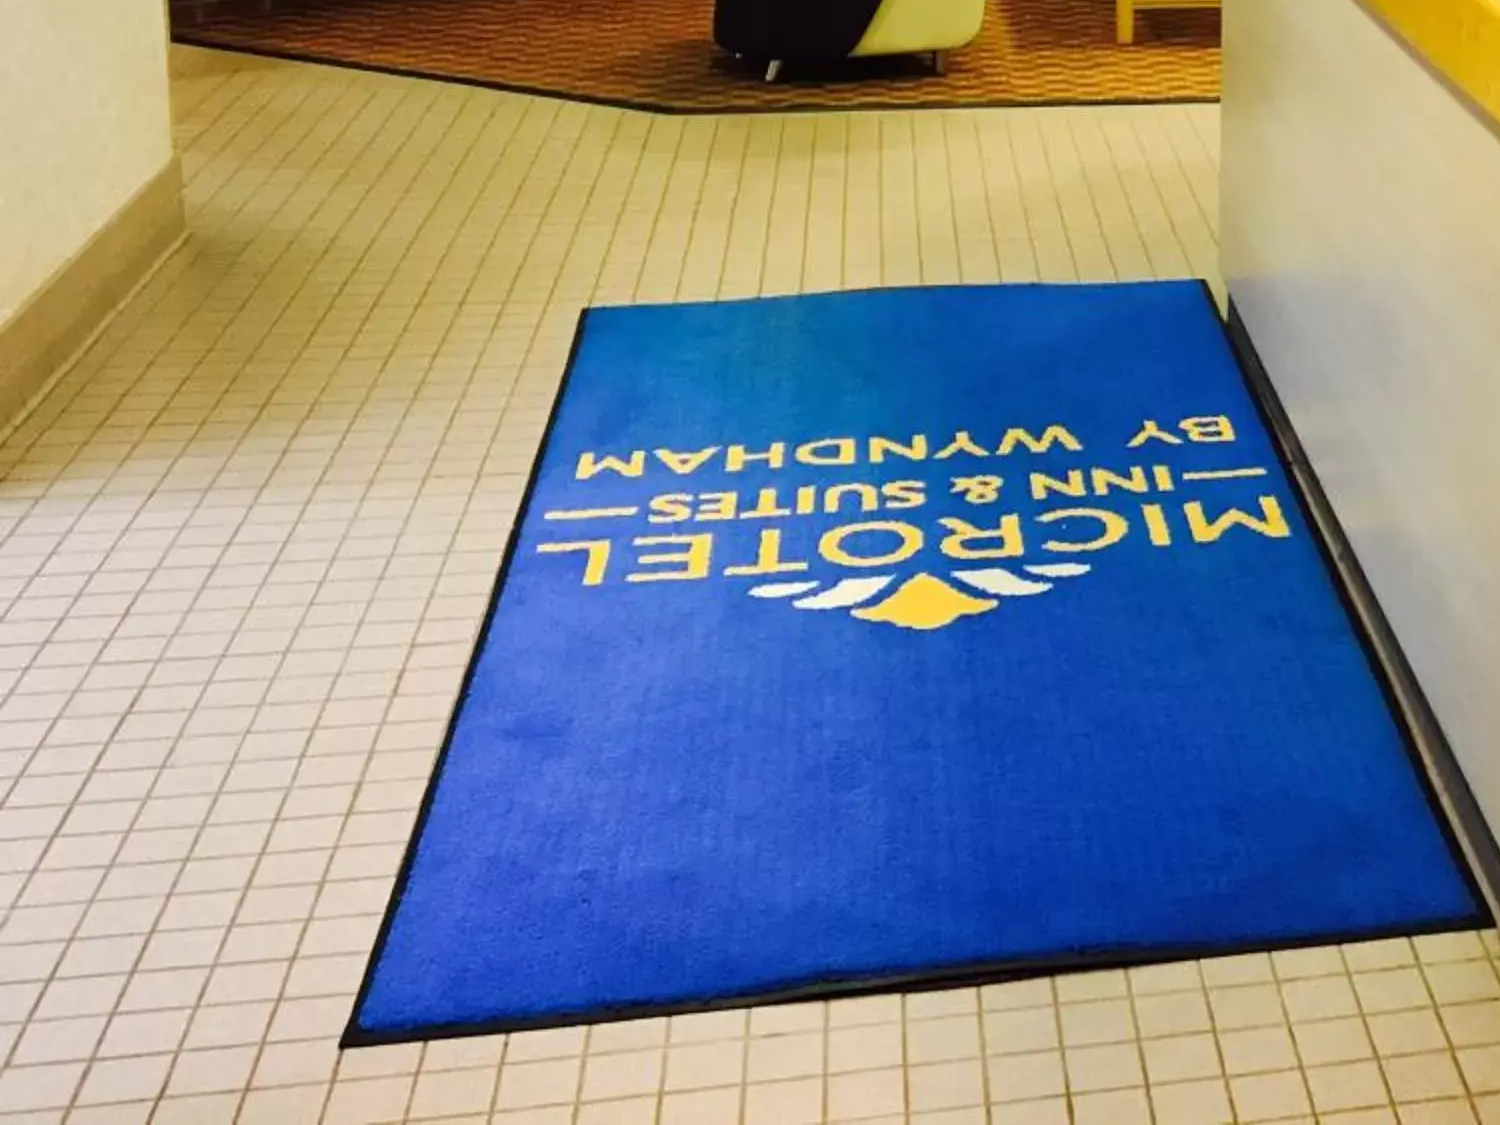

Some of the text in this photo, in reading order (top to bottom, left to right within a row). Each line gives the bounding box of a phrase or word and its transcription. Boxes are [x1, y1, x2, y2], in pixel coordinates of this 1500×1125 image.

[576, 417, 1234, 479] BY WYNDHAM
[650, 466, 1173, 523] INN & SUITES
[539, 497, 1289, 586] MICROTEL
